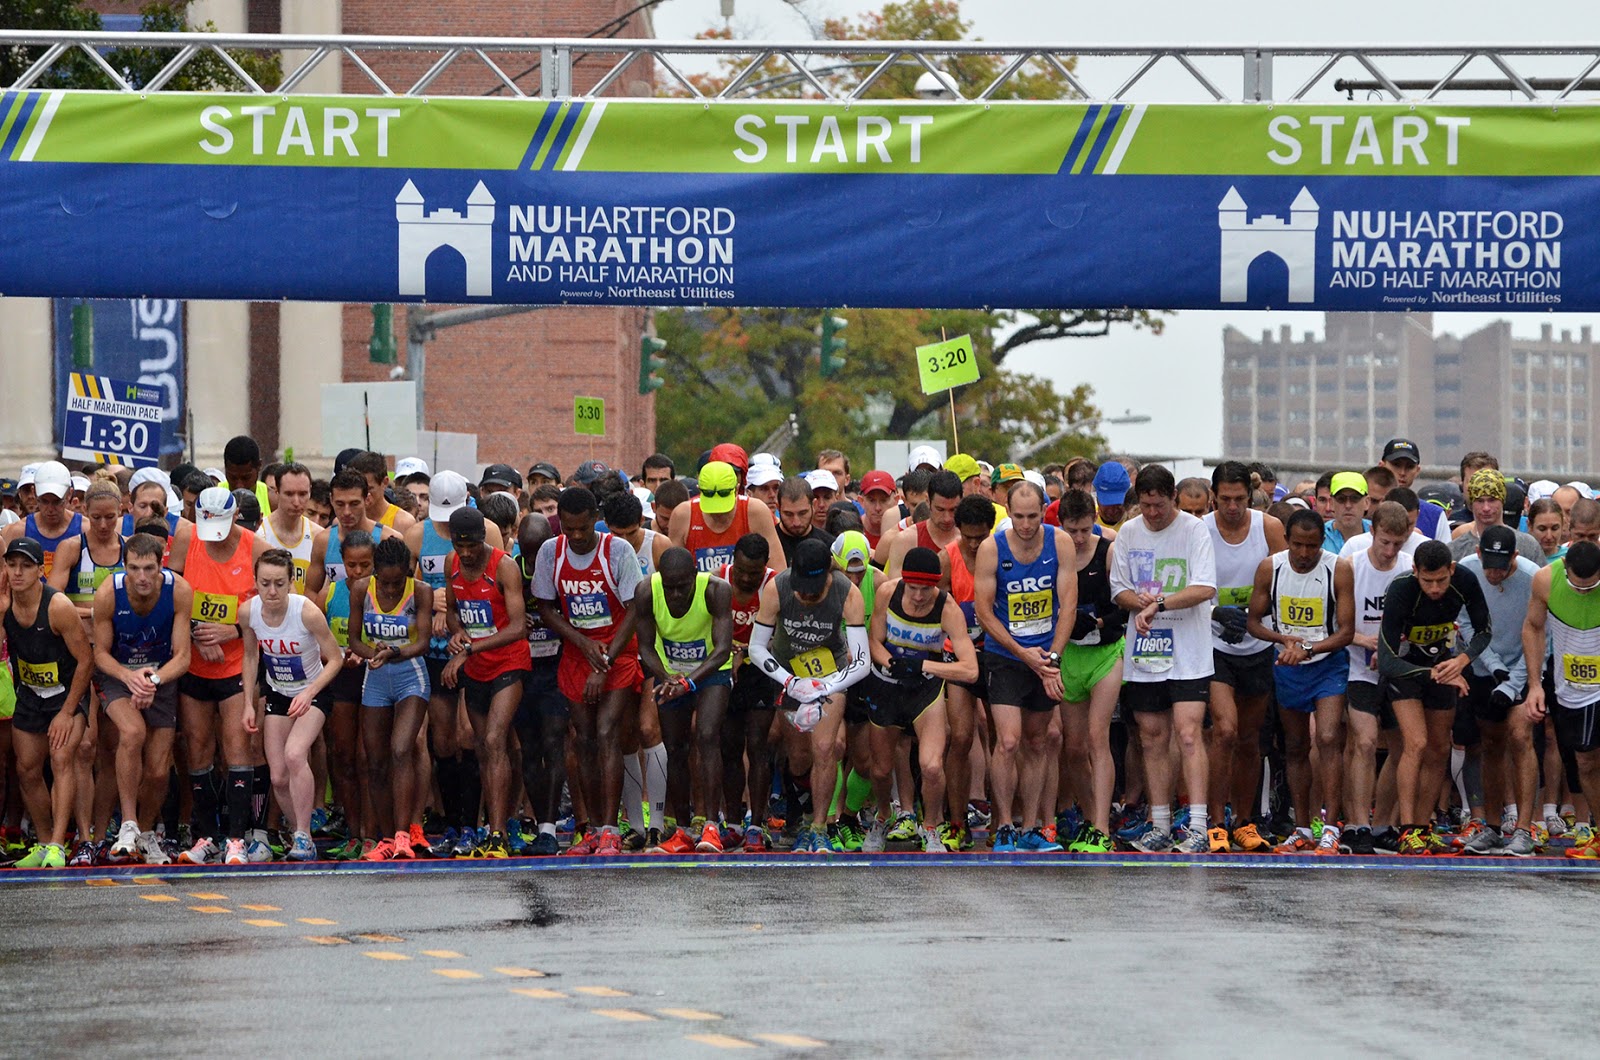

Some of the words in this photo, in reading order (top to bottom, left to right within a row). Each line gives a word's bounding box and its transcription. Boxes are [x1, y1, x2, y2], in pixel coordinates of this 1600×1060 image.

[198, 107, 401, 158] START
[732, 114, 935, 164] START
[1267, 116, 1472, 166] START
[509, 205, 736, 235] NUHARTFORD
[1333, 210, 1564, 239] NUHARTFORD
[509, 235, 734, 264] MARATHON
[1332, 241, 1561, 269] MARATHON
[506, 265, 553, 282] AND
[559, 265, 609, 283] HALF
[616, 267, 734, 284] MARATHON
[1329, 271, 1376, 288] AND
[1383, 271, 1434, 288] HALF
[1440, 271, 1561, 288] MARATHON
[560, 290, 593, 298] Powered
[594, 290, 604, 299] by
[608, 286, 676, 298] Northeast
[680, 287, 735, 299] Utilities
[1383, 295, 1416, 303] Powered
[1418, 295, 1428, 304] by
[1432, 291, 1502, 303] Northeast
[1505, 291, 1562, 304] Utilities
[928, 347, 967, 373] 3:20
[71, 397, 92, 410] HALF
[93, 400, 137, 417] MARATHON
[138, 406, 159, 420] PACE
[578, 405, 600, 421] 3:30
[80, 415, 149, 454] 1:30
[698, 554, 735, 571] 1087
[561, 579, 605, 595] WSX
[1006, 575, 1052, 593] GRC
[200, 601, 228, 618] 879
[570, 601, 604, 616] 9454
[1013, 598, 1048, 616] 2687
[1288, 605, 1314, 621] 979
[460, 608, 488, 624] 5011
[784, 618, 820, 630] HOKA
[365, 621, 407, 637] 11500
[665, 645, 706, 660] 12337
[1136, 637, 1173, 652] 10902
[804, 657, 823, 676] 13
[1570, 663, 1598, 679] 865
